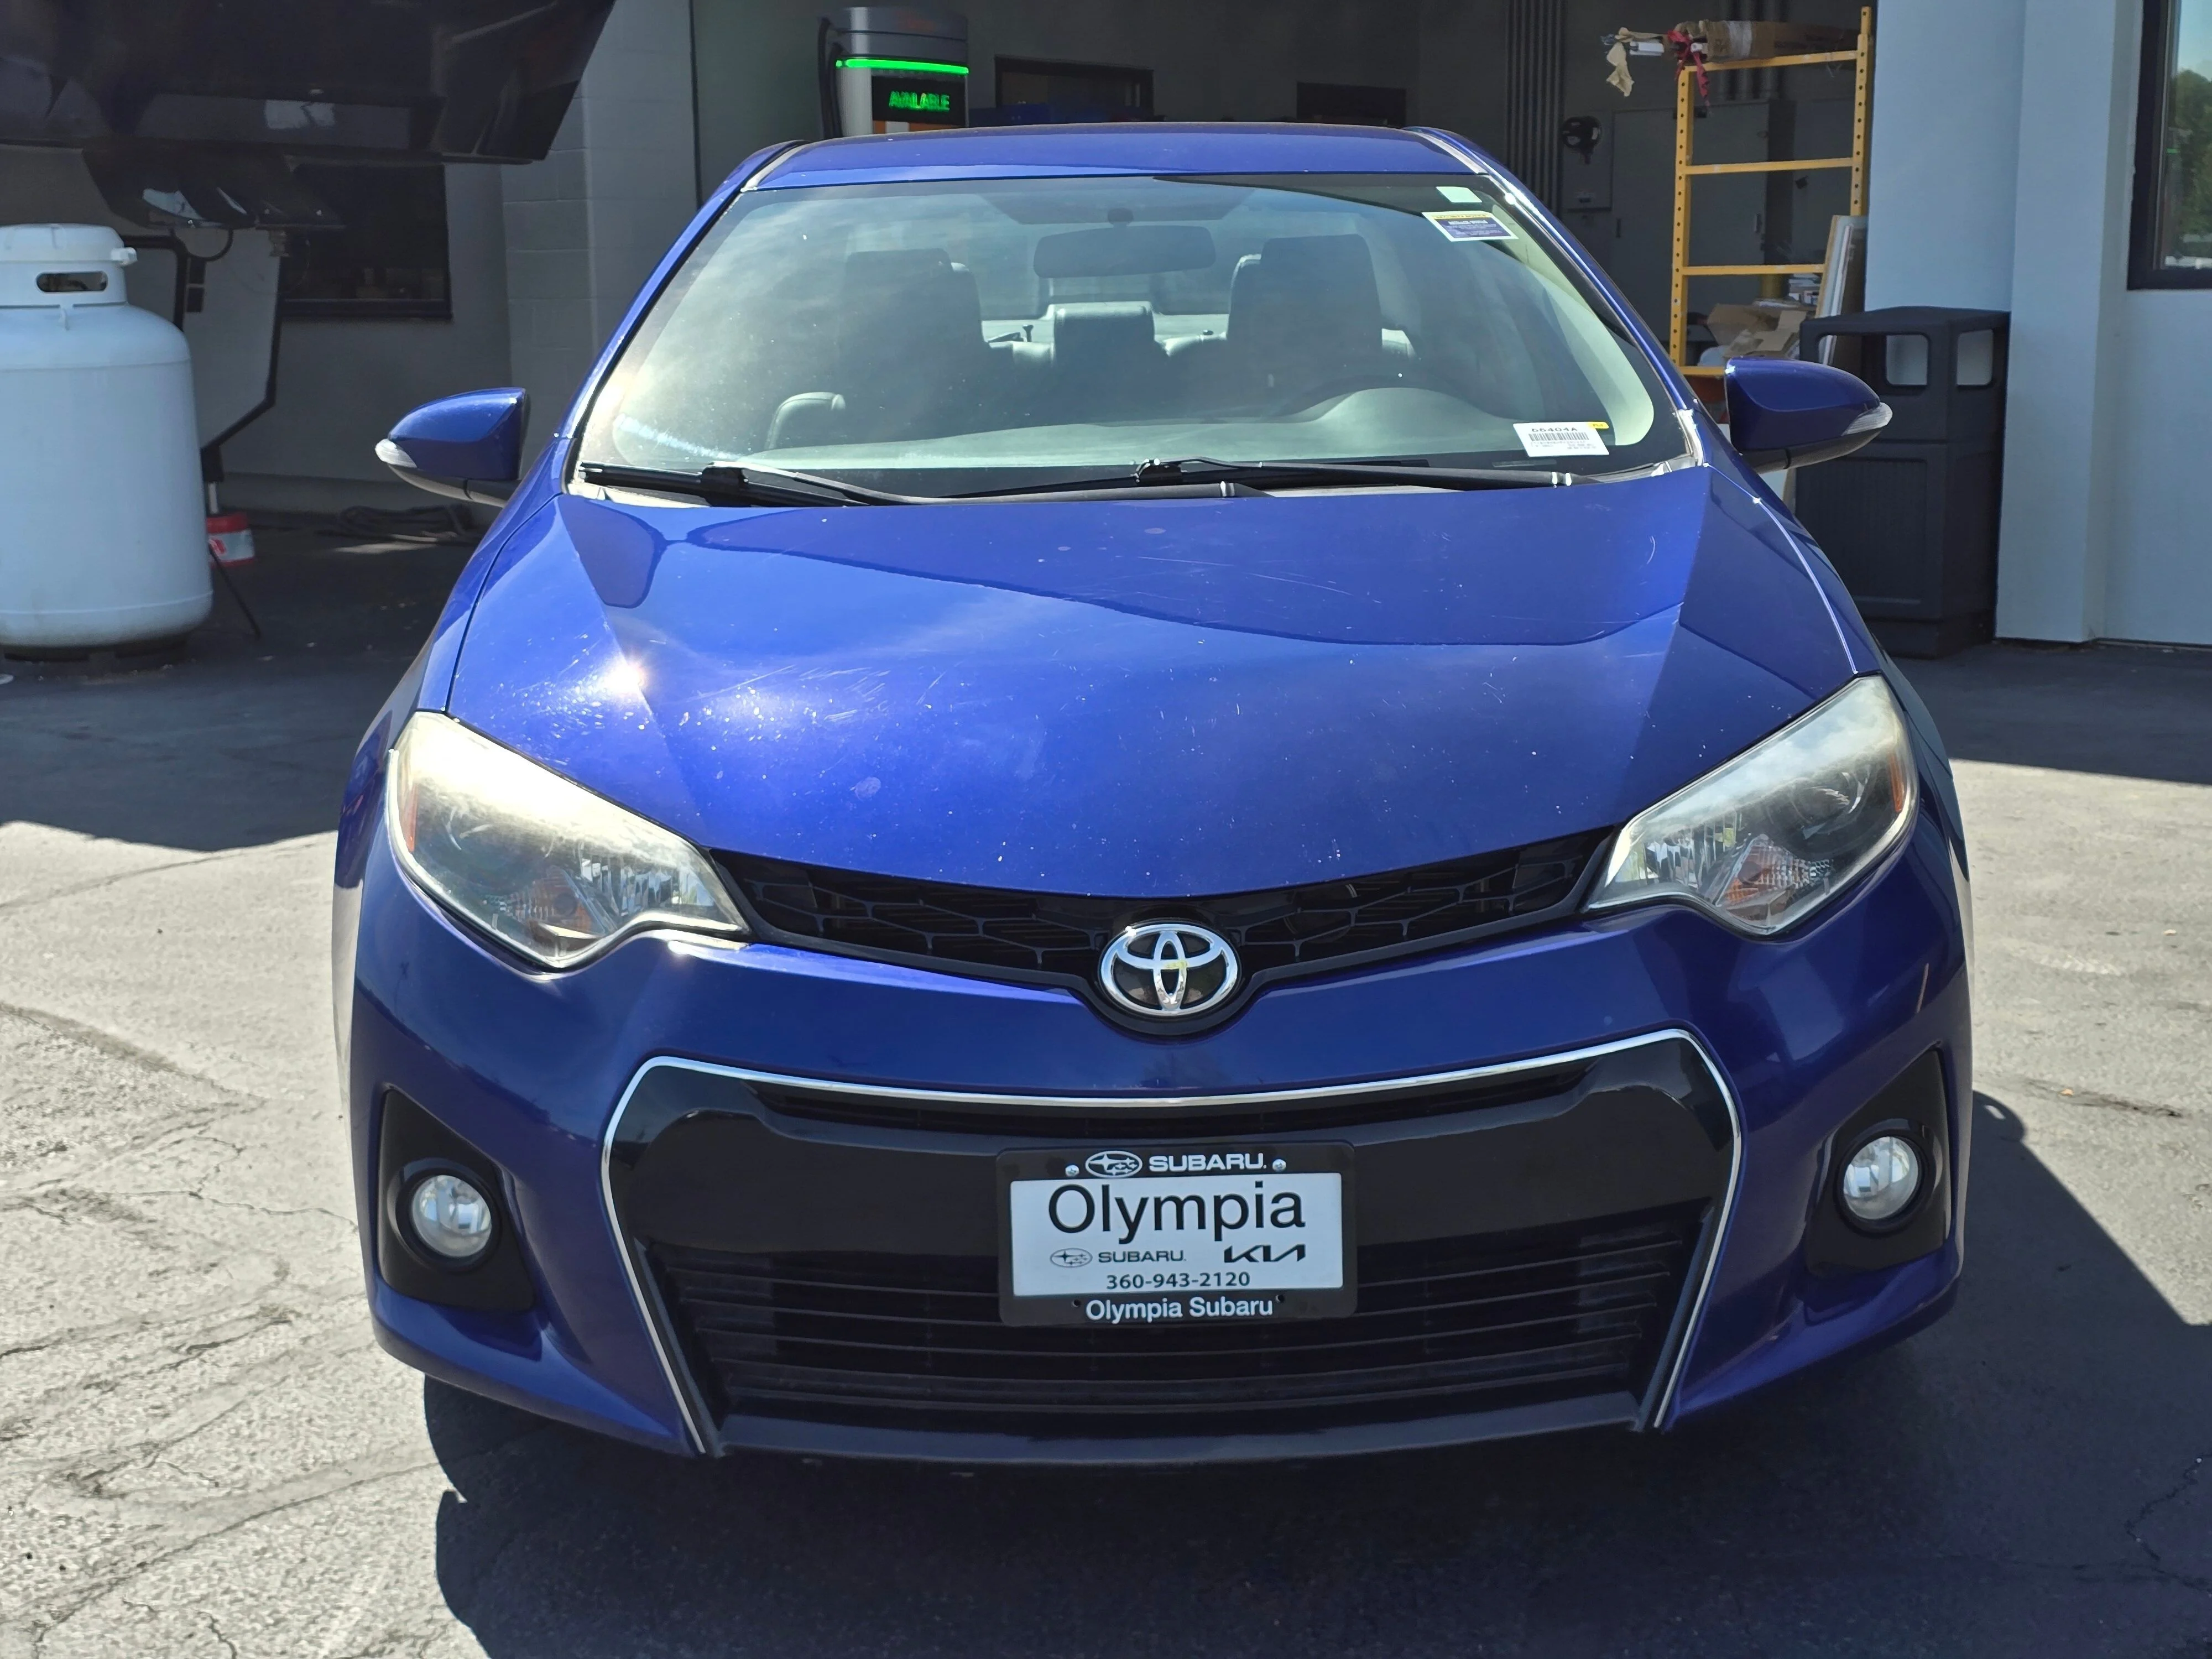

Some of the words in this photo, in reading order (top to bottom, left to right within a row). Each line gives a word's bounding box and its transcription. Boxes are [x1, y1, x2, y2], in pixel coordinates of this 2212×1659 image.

[1149, 1153, 1265, 1172] SUBARU
[1048, 1181, 1306, 1245] Olympia
[1098, 1250, 1185, 1263] SUBARU
[1107, 1271, 1250, 1290] 360-943-2120
[1086, 1297, 1183, 1324] Olympia
[1190, 1296, 1273, 1317] Subaru
